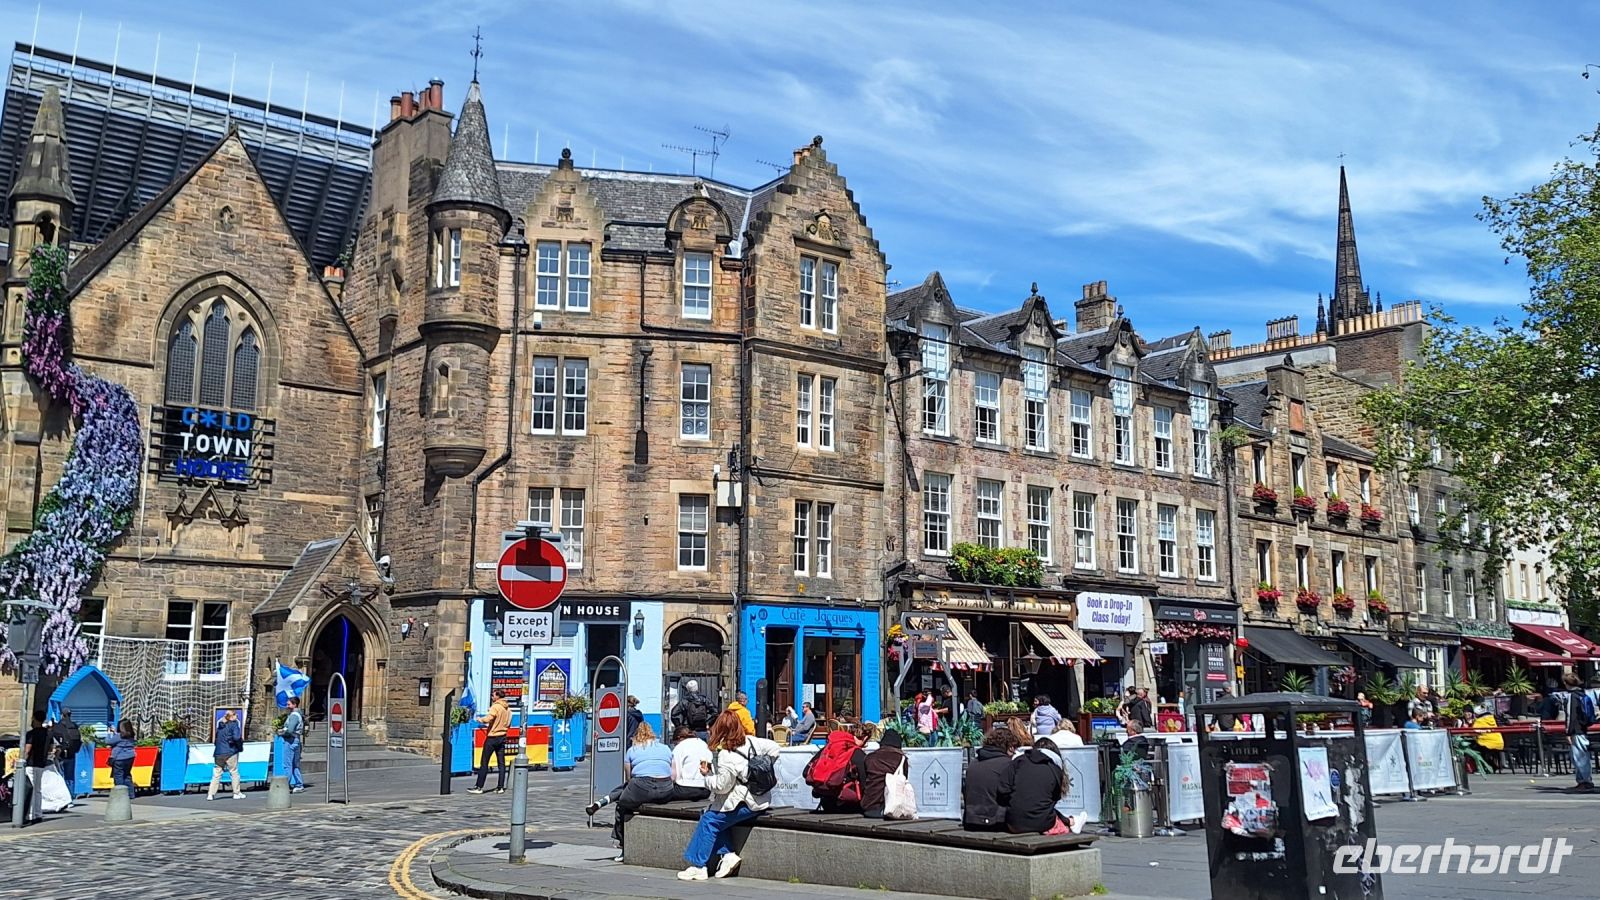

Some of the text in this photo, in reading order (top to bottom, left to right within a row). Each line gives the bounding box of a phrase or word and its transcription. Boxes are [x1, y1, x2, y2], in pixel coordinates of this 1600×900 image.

[180, 432, 250, 457] TOWN
[176, 457, 249, 479] HOUSE
[577, 605, 619, 616] HOUSE
[1087, 597, 1132, 612] Book a Drop-In
[508, 615, 548, 627] Except
[782, 607, 806, 620] Café
[814, 608, 853, 624] Jacques
[1092, 611, 1130, 626] Class Today!
[509, 628, 546, 639] cycles
[607, 741, 618, 749] Entry
